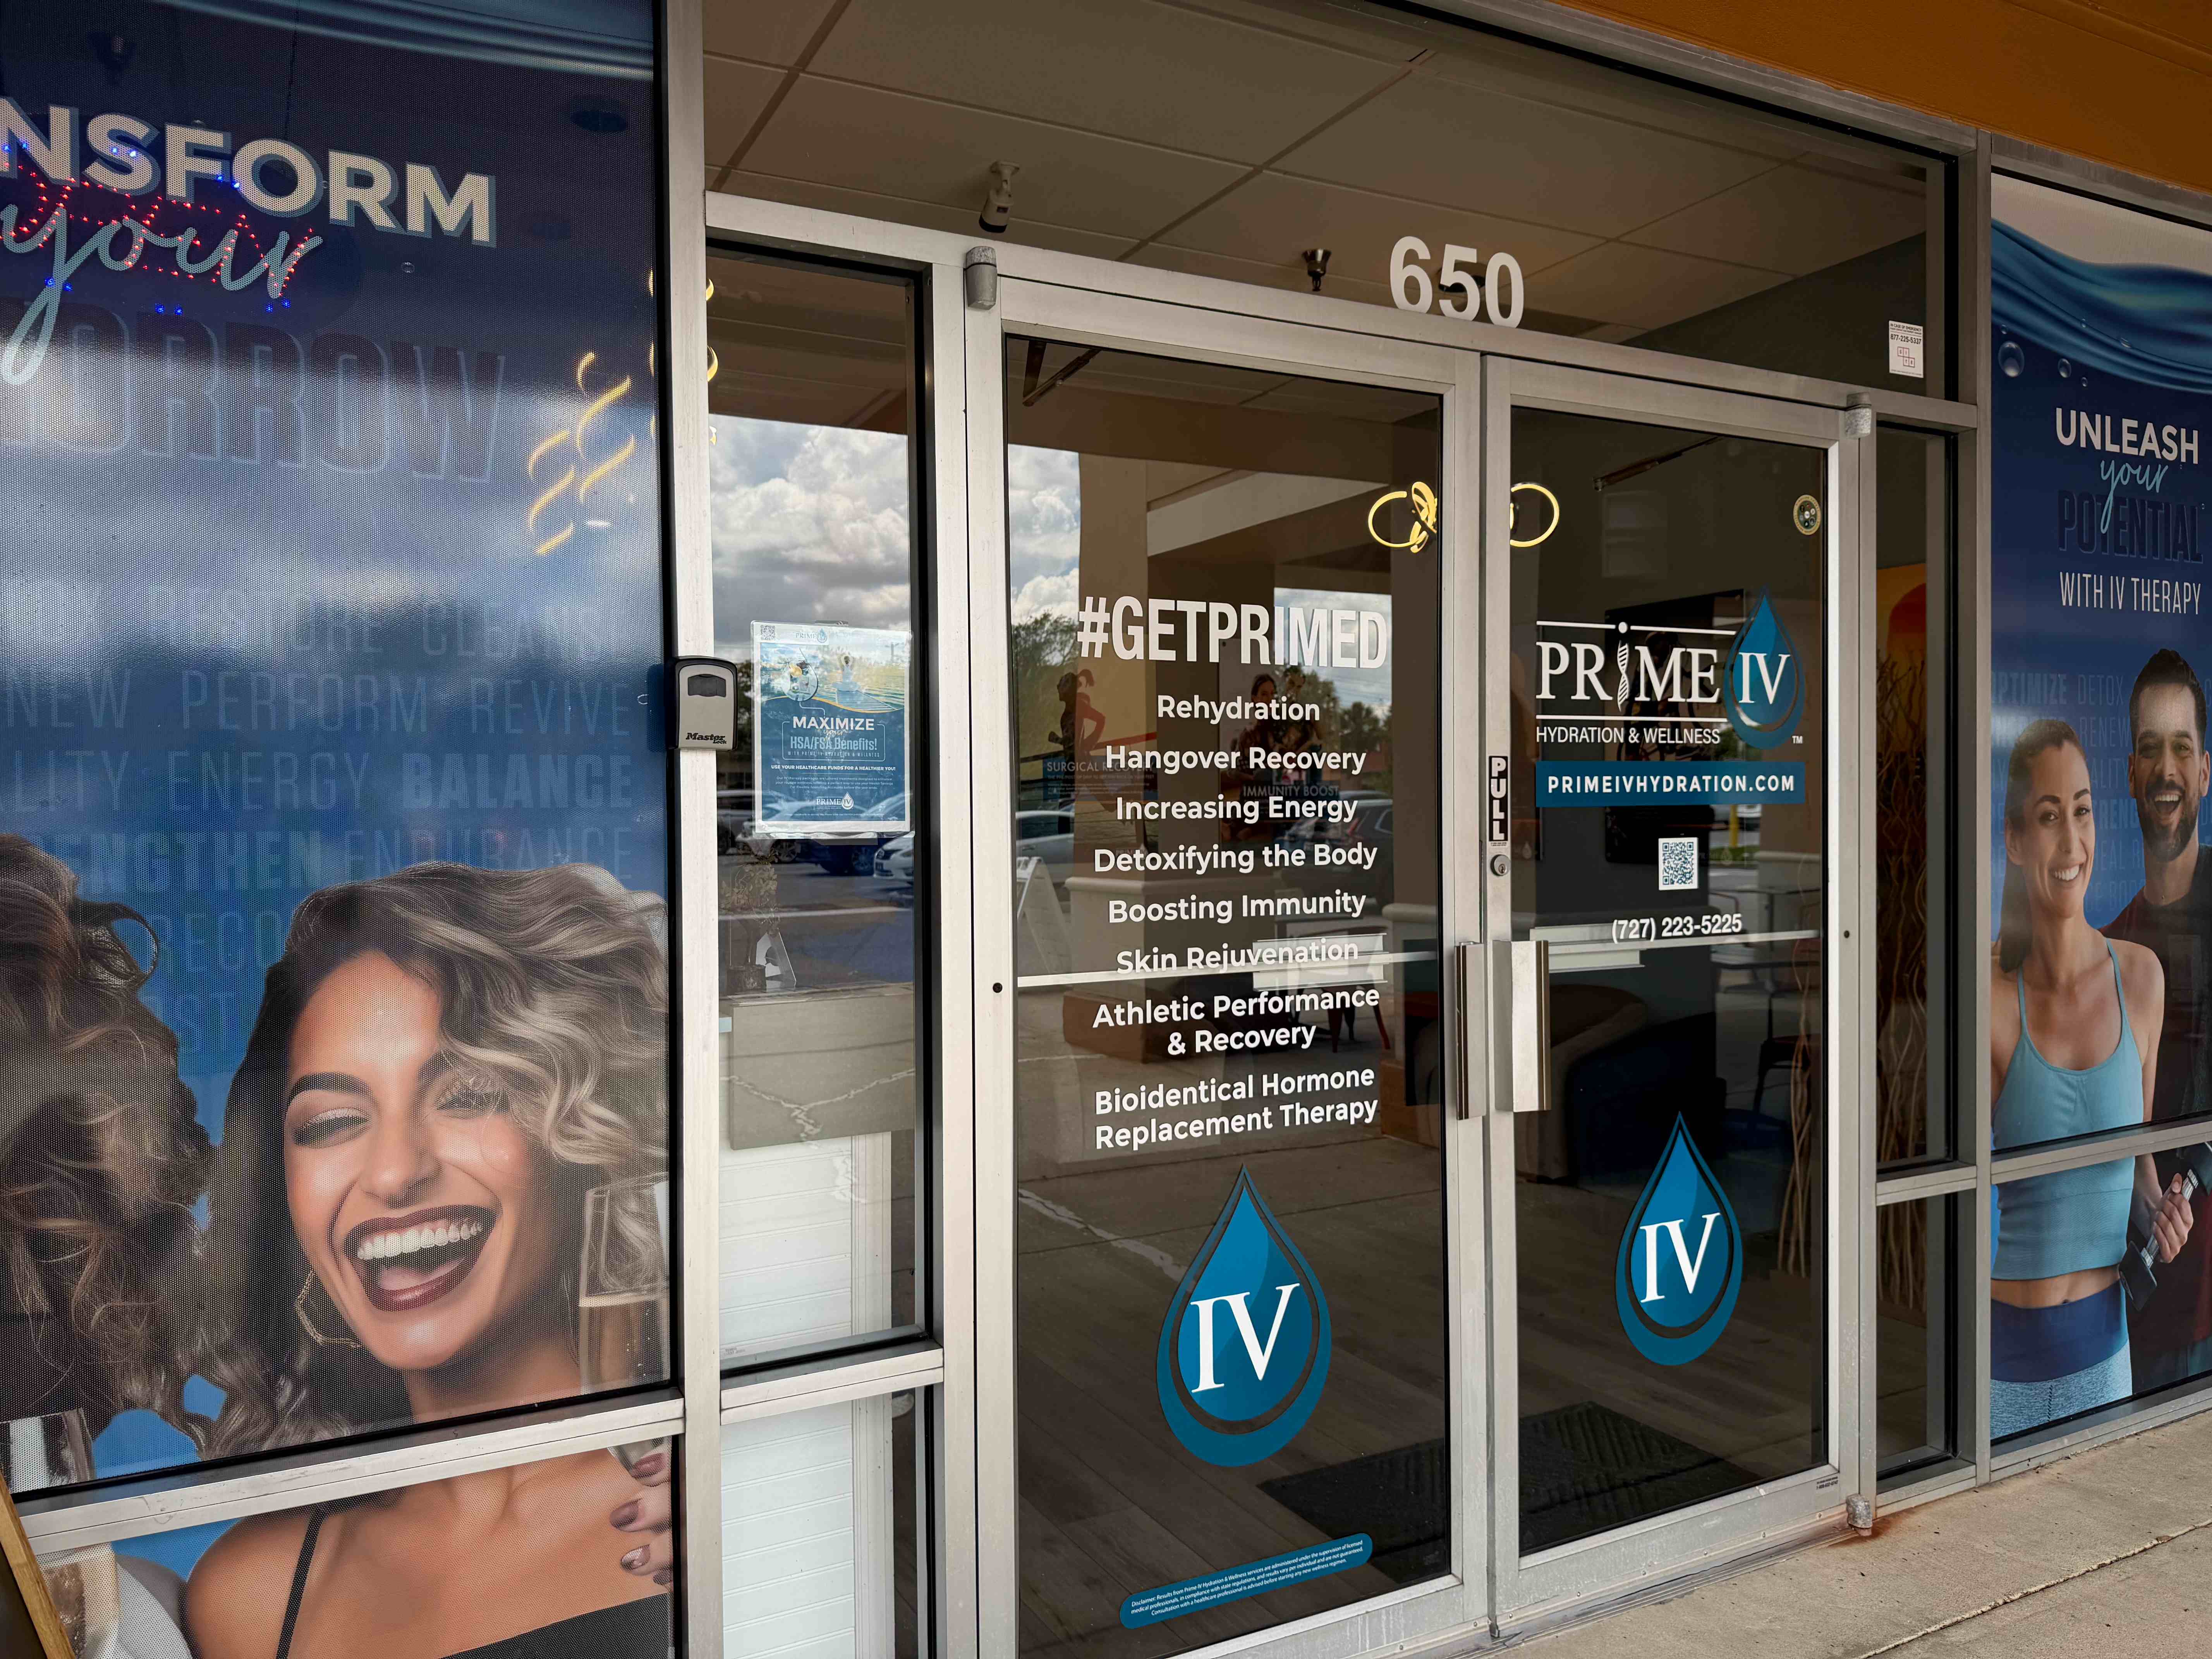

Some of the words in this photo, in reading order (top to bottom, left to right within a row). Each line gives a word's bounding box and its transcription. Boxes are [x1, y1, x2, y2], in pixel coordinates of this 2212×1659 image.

[0, 98, 497, 247] NSFORM
[0, 203, 323, 385] your
[1390, 235, 1524, 329] 650
[1890, 333, 1922, 344] 877-225-5337
[2056, 407, 2198, 464] UNLEASH
[2100, 460, 2168, 534] your
[2058, 489, 2203, 564] POTENTIAL
[2060, 572, 2103, 608] WITH
[2110, 575, 2125, 610] IV
[2131, 577, 2201, 615] THERAPY
[1077, 596, 1388, 668] #GETPRIMED
[1536, 622, 1720, 712] PRIME
[1738, 652, 1791, 704] IV
[182, 670, 427, 733] PERFORM
[469, 677, 629, 736] REVIVE
[1158, 695, 1320, 725] Rehydration
[2078, 674, 2123, 706] DETOX
[790, 736, 832, 750] HSA/FSA
[835, 737, 878, 750] Benefits!
[793, 716, 874, 731] MAXIMIZE
[1536, 727, 1624, 744] HYDRATION
[1628, 728, 1639, 743] &
[1643, 728, 1720, 744] WELLNESS
[1792, 735, 1803, 744] TM
[168, 750, 369, 811] ENERGY
[401, 753, 633, 810] BALANCE
[1047, 761, 1100, 772] SURGICAL
[1106, 745, 1240, 775] Hangover
[1249, 746, 1366, 775] Recovery
[1243, 785, 1300, 797] IMMUNITY
[1304, 785, 1339, 796] BOOST
[1491, 757, 1507, 840] PULL
[1548, 775, 1795, 793] PRIMEIVHYDRATION.COM
[1116, 794, 1260, 824] Increasing
[1268, 795, 1358, 823] Energy
[33, 830, 323, 894] ENGTHEN
[1094, 843, 1255, 874] Detoxifying
[1262, 844, 1305, 867] the
[1313, 842, 1377, 870] Body
[1108, 895, 1233, 924] Boosting
[1242, 889, 1366, 917] Immunity
[1612, 918, 1656, 943] (727)
[1661, 914, 1742, 937] 223-5225
[1116, 947, 1177, 974] Skin
[1187, 938, 1358, 974] Rejuvenation
[1092, 995, 1205, 1028] Athletic
[1214, 988, 1379, 1019] Performance
[1167, 1032, 1186, 1056] &
[1195, 1023, 1316, 1053] Recovery
[1095, 1074, 1254, 1115] Bioidentical
[1261, 1068, 1374, 1097] Hormone
[1096, 1106, 1272, 1150] Replacement
[1279, 1097, 1378, 1128] Therapy
[1639, 1212, 1721, 1304] IV
[1191, 1283, 1300, 1394] IV
[1131, 1604, 1149, 1614] medical
[1149, 1598, 1179, 1610] professionals,
[1185, 1590, 1210, 1600] compliance
[1232, 1577, 1256, 1588] regulations,
[1297, 1559, 1317, 1568] individual
[1132, 1597, 1156, 1607] Disclaimer:
[1156, 1592, 1172, 1600] Results
[1203, 1578, 1224, 1588] Hydration
[1228, 1572, 1247, 1580] Wellness
[1247, 1567, 1264, 1576] services
[1271, 1557, 1298, 1569] administered
[1319, 1546, 1341, 1557] supervision
[1346, 1540, 1363, 1548] licensed
[1151, 1605, 1180, 1616] Consultation
[1194, 1594, 1217, 1604] healthcare
[1217, 1587, 1243, 1599] professional
[1247, 1580, 1264, 1589] advised
[1278, 1572, 1294, 1581] starting
[1312, 1563, 1329, 1572] wellness
[1329, 1559, 1347, 1567] regimen.
